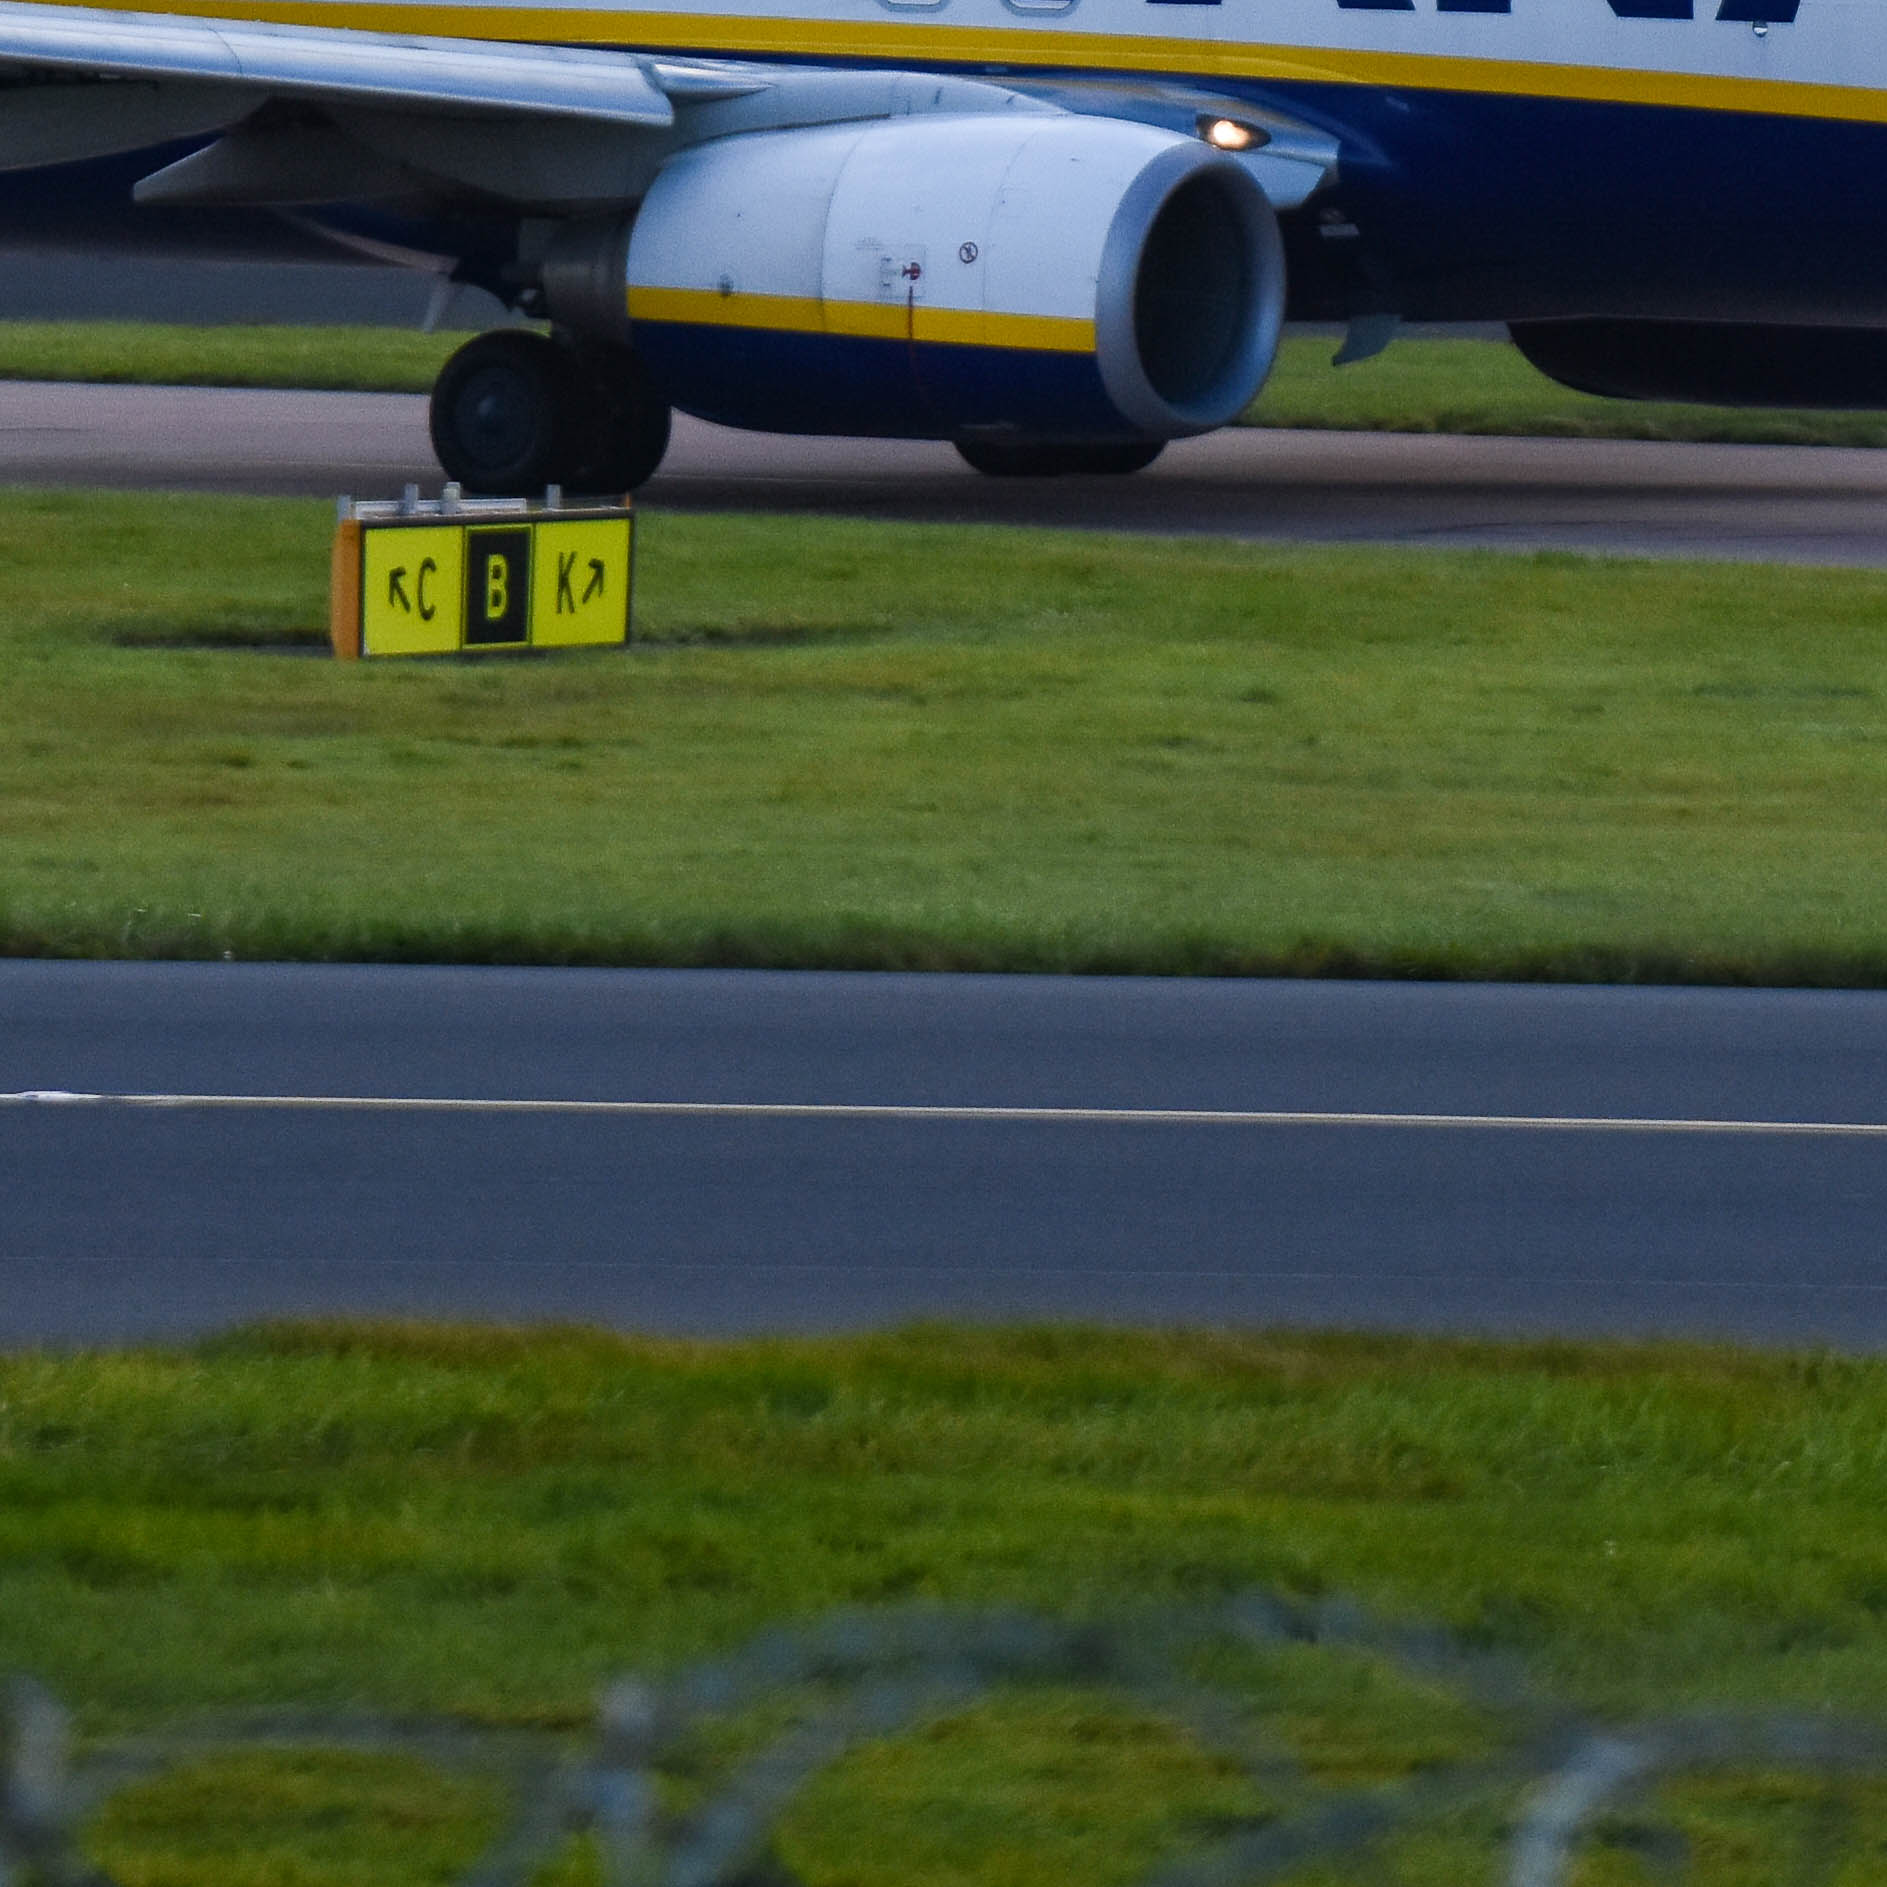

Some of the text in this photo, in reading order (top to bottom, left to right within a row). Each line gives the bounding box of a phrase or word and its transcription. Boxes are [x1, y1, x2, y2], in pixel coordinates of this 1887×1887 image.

[417, 552, 577, 622] C B K
